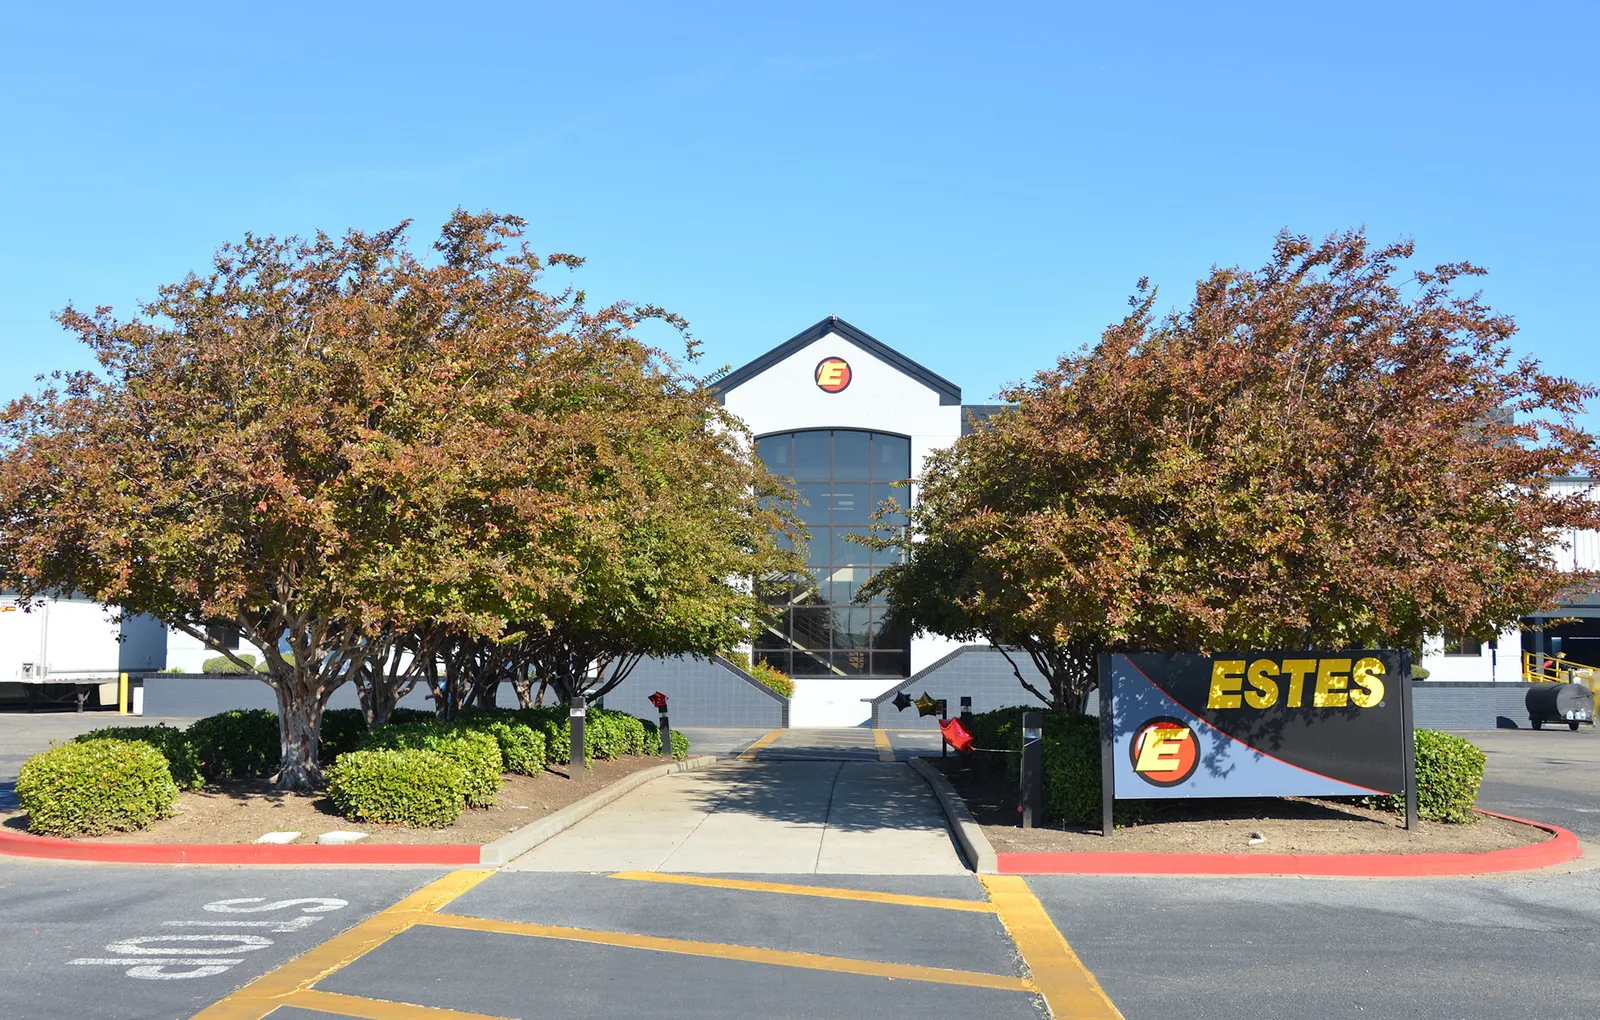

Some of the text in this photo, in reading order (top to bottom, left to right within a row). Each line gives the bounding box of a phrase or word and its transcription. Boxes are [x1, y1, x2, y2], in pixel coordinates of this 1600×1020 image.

[817, 362, 848, 386] E
[1207, 657, 1386, 709] ESTES
[1134, 728, 1191, 773] E
[67, 897, 348, 979] STOP
